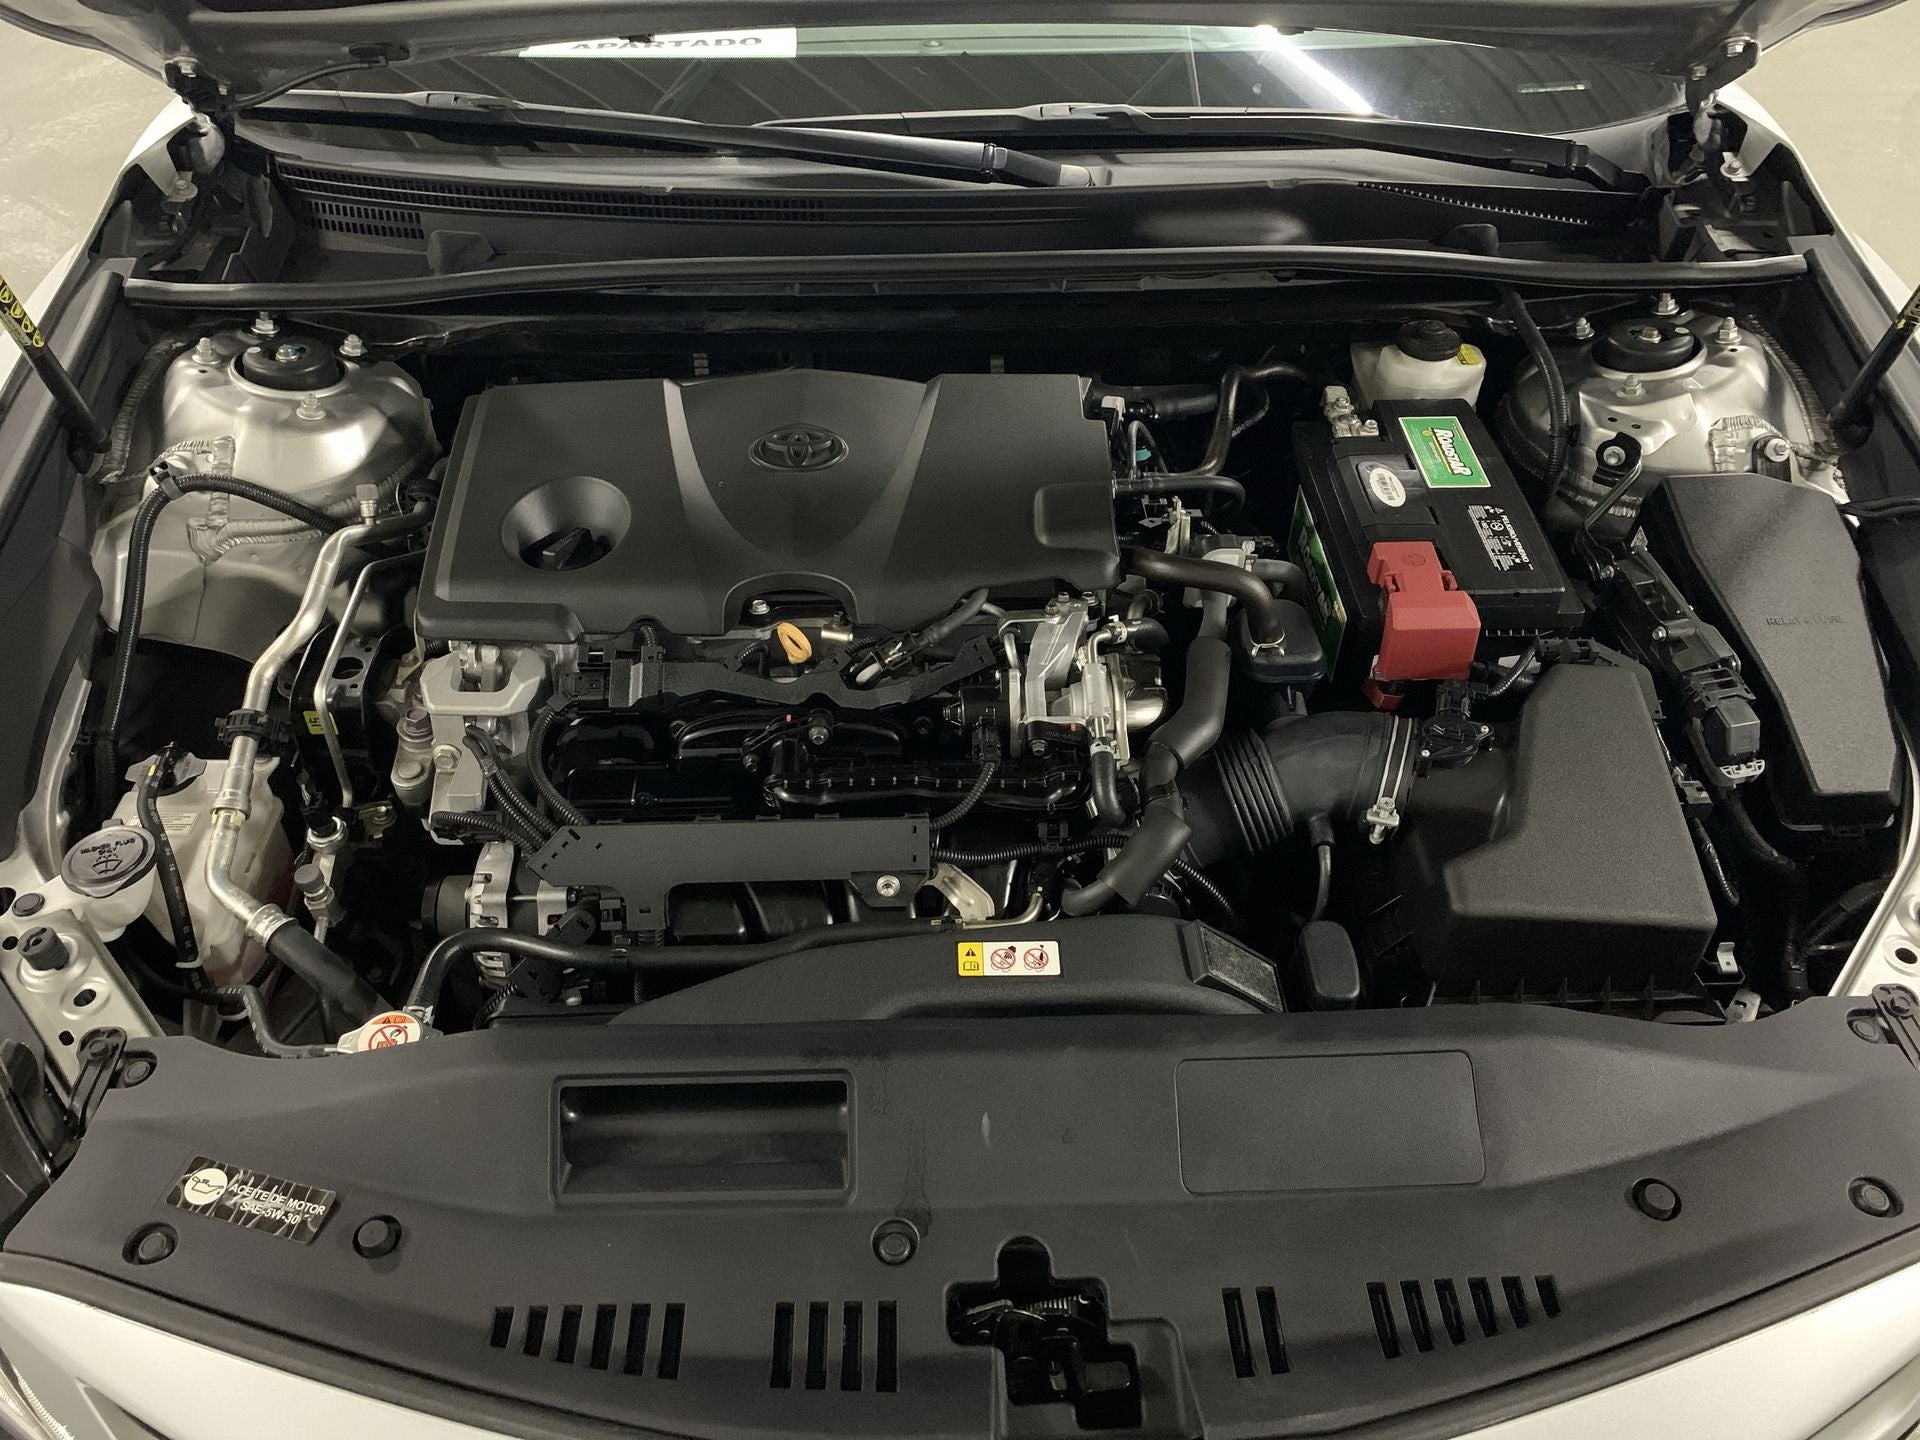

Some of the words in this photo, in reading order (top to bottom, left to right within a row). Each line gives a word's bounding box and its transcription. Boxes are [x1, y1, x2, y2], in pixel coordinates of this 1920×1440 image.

[571, 37, 762, 50] APARTADO
[1432, 427, 1473, 476] ROADSTAR
[228, 1183, 270, 1200] ACEITE
[270, 1193, 287, 1205] DE
[287, 1198, 326, 1216] MOTOR
